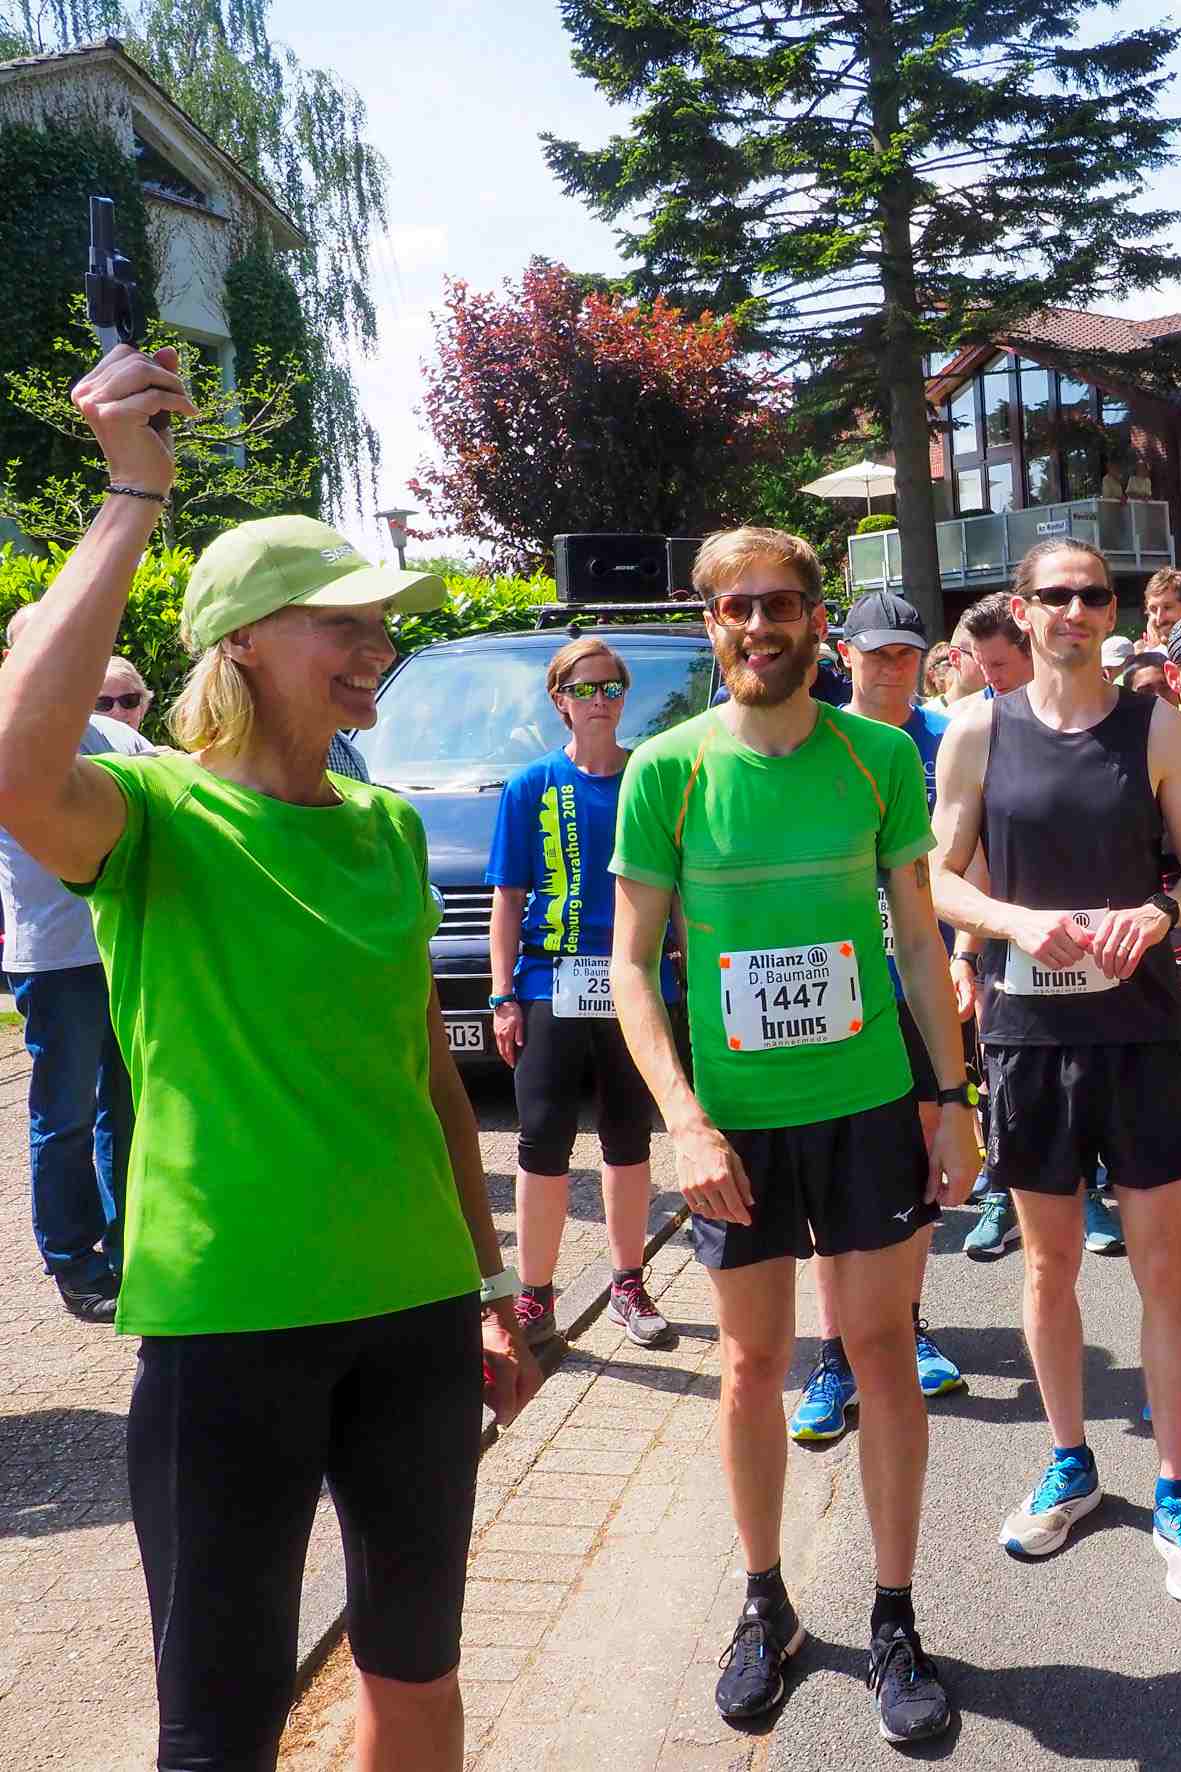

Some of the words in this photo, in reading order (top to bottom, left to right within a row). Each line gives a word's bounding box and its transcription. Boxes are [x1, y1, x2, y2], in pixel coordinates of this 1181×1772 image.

[561, 784, 576, 819] 2018
[565, 822, 581, 897] Marathon
[574, 958, 609, 968] Allianz
[749, 954, 804, 970] Allianz
[585, 968, 609, 977] Baum
[749, 972, 764, 985] D.
[767, 967, 830, 984] Baumann
[1032, 966, 1087, 987] bruns
[587, 978, 610, 994] 25
[754, 981, 828, 1012] 1447
[762, 1015, 827, 1040] bruns
